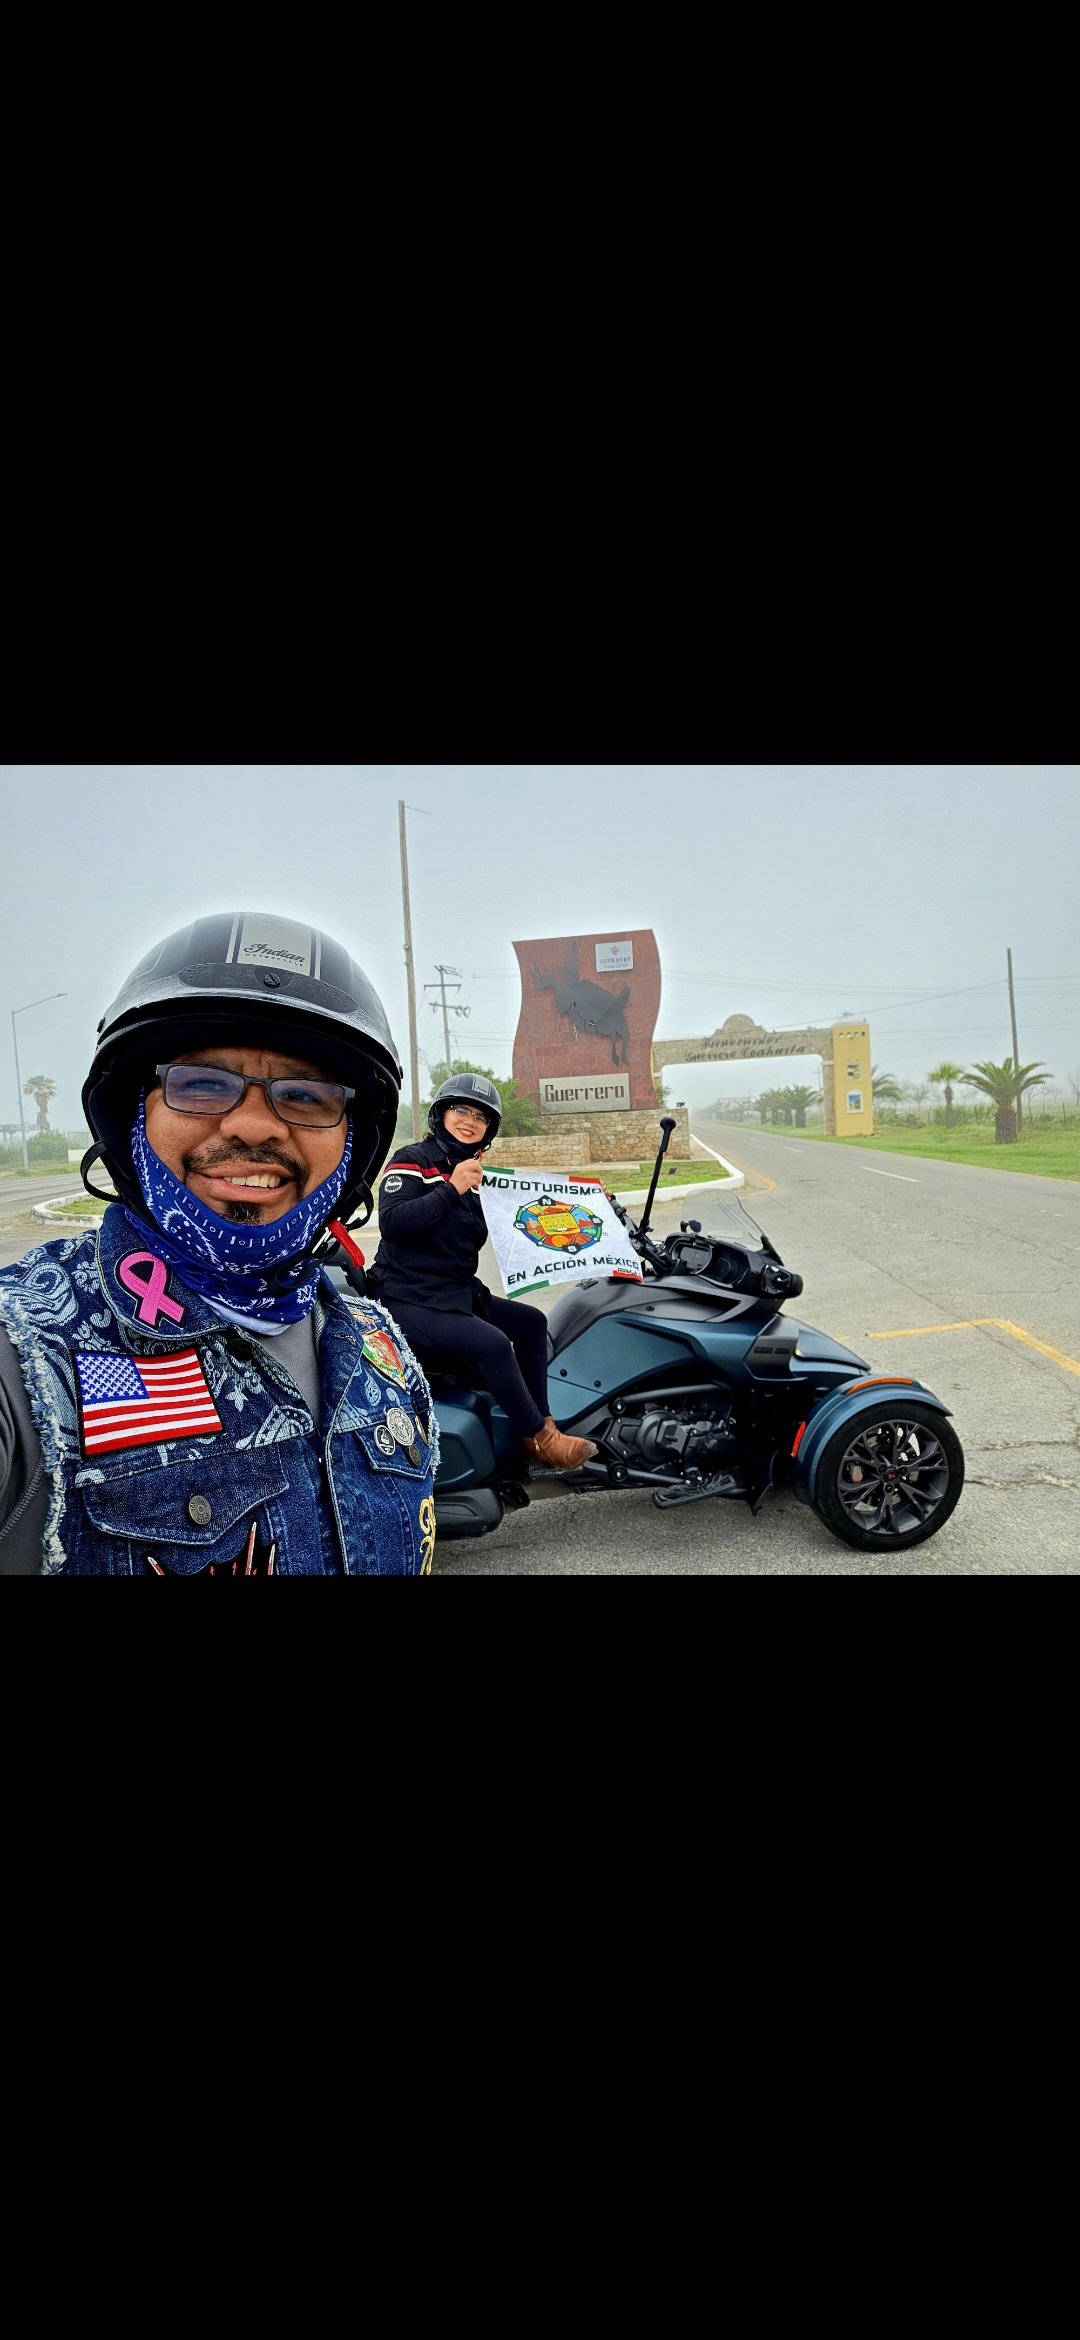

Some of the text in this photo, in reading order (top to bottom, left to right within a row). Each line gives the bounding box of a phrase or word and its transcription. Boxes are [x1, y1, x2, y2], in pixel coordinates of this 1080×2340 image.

[244, 943, 305, 962] Indian
[544, 1084, 625, 1103] Guerrero
[481, 1175, 602, 1196] MOTOTURISMO
[507, 1254, 639, 1285] EN ACCIÓN MÉXICO
